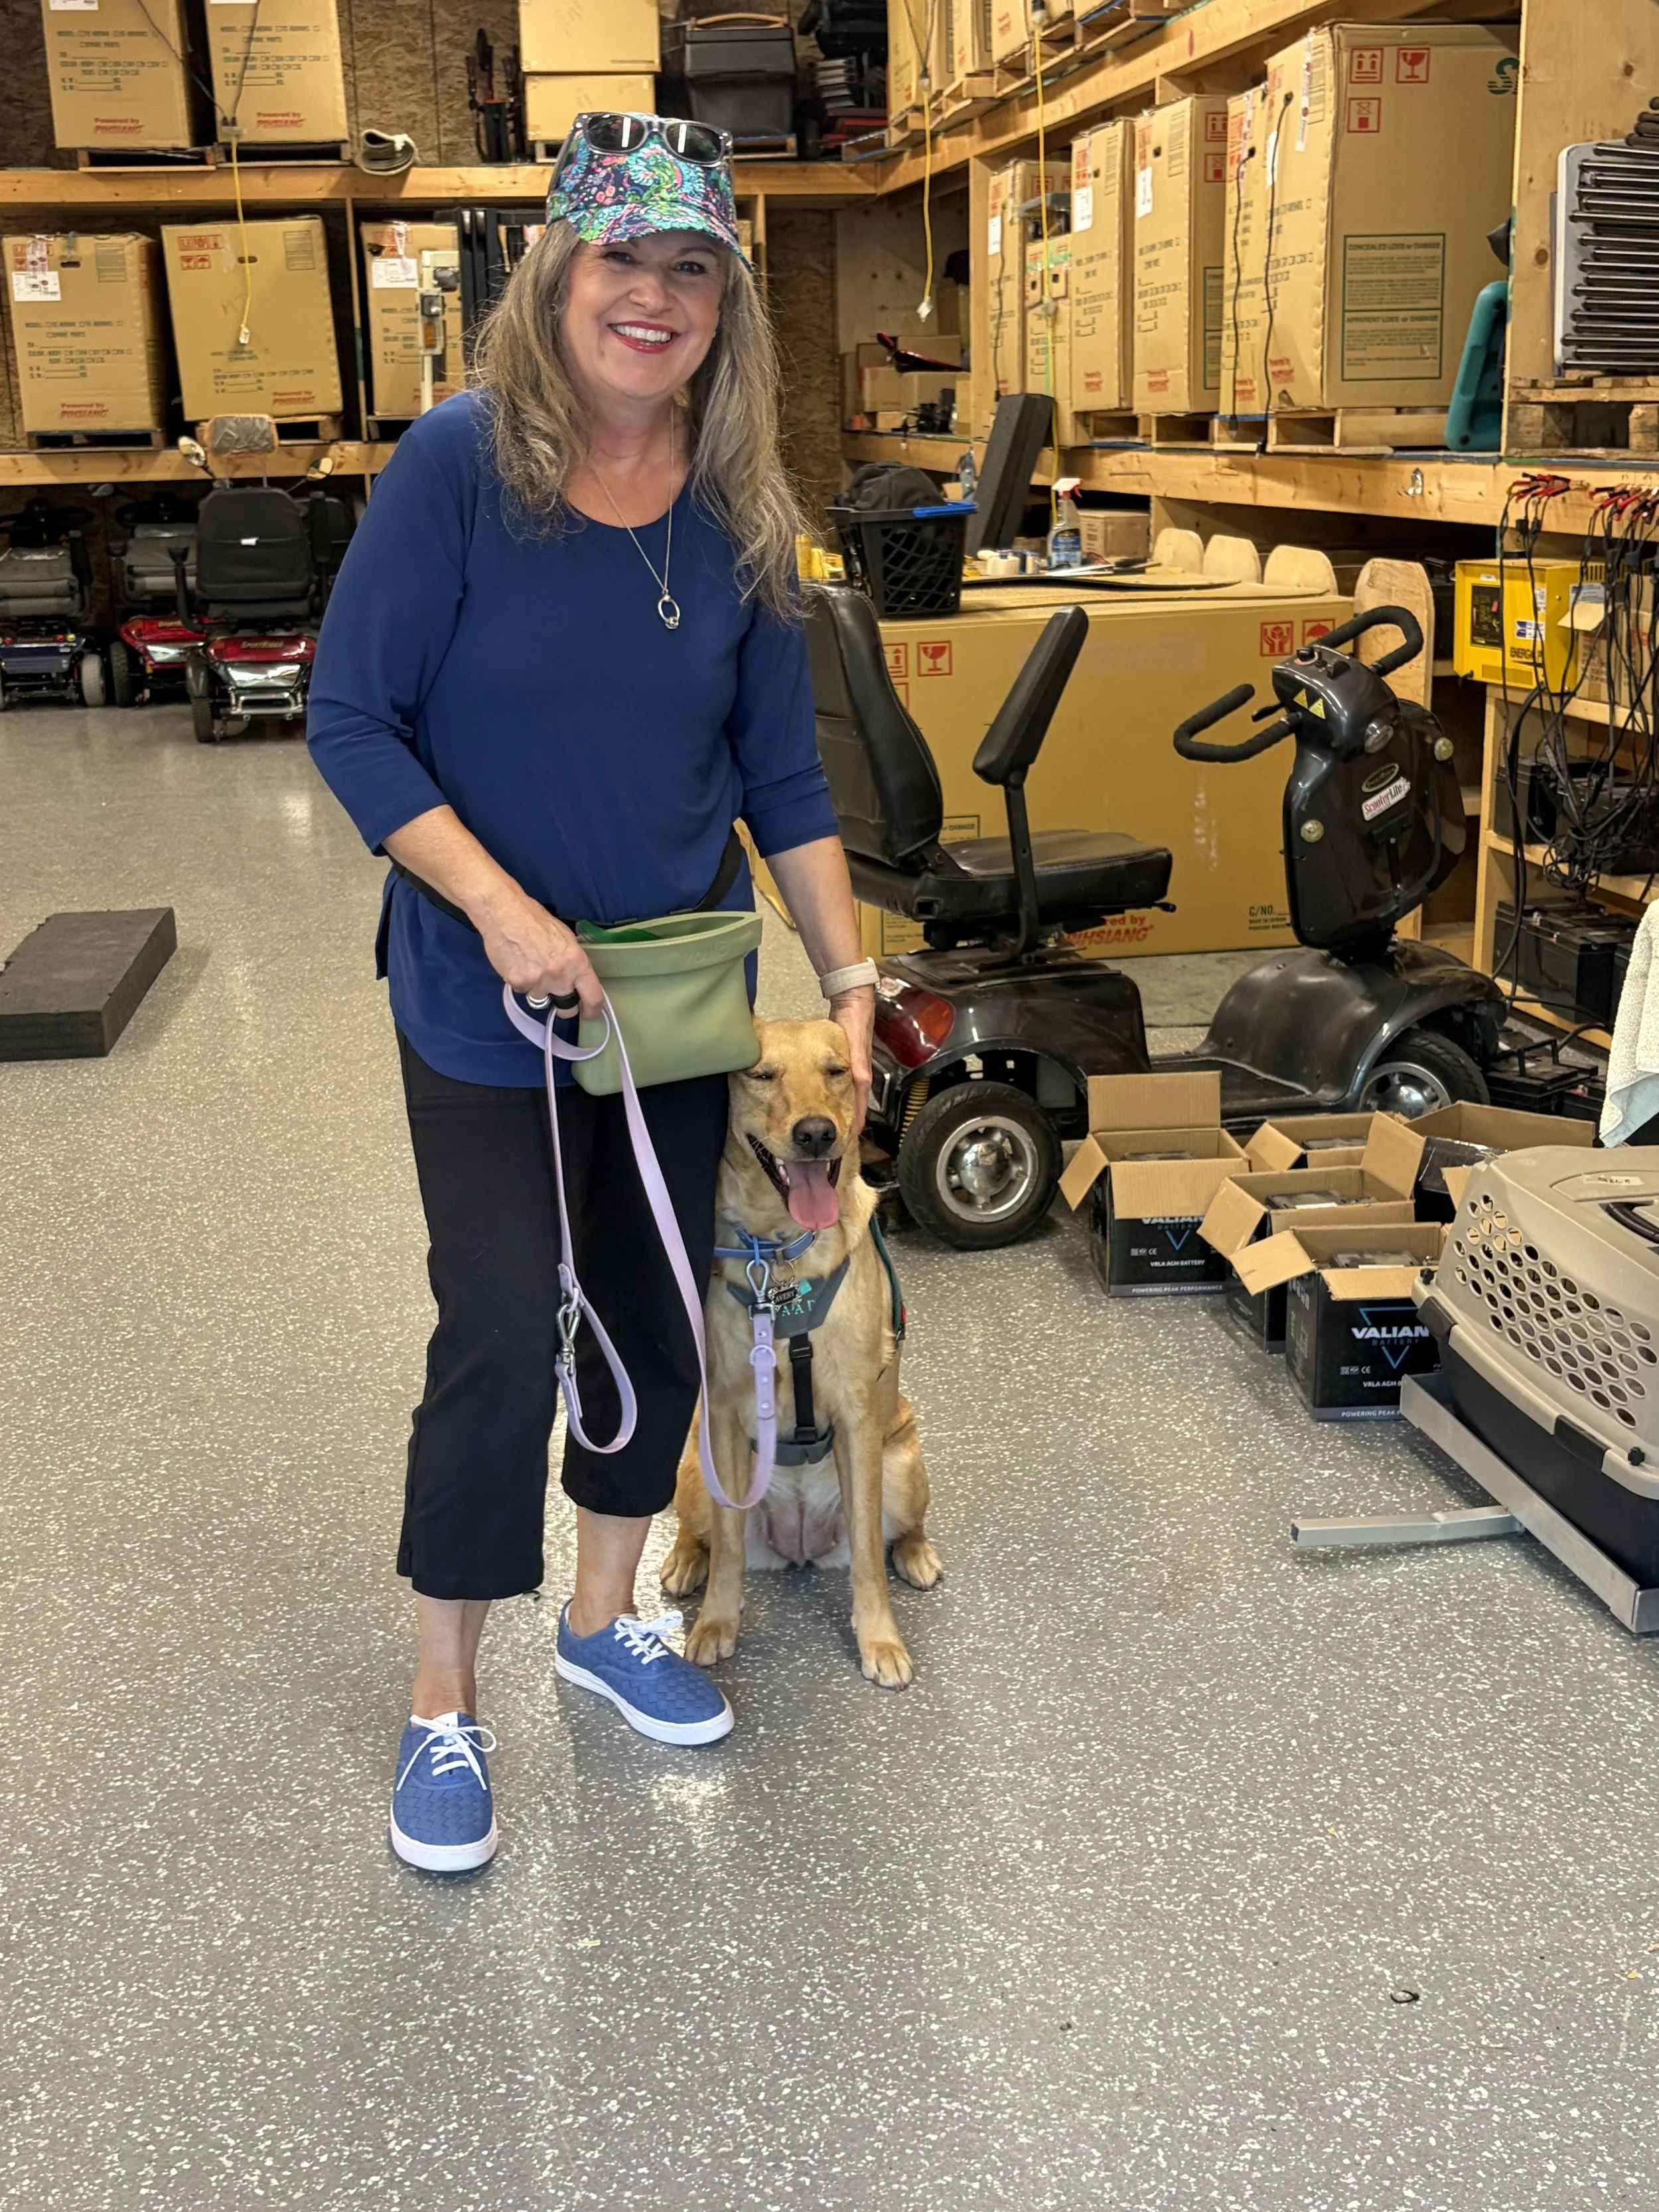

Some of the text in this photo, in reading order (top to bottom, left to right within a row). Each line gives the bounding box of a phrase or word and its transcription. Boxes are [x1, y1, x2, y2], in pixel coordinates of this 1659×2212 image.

[1130, 915, 1146, 926] by
[774, 1289, 795, 1303] AVERY
[1351, 1326, 1429, 1339] VALIAN
